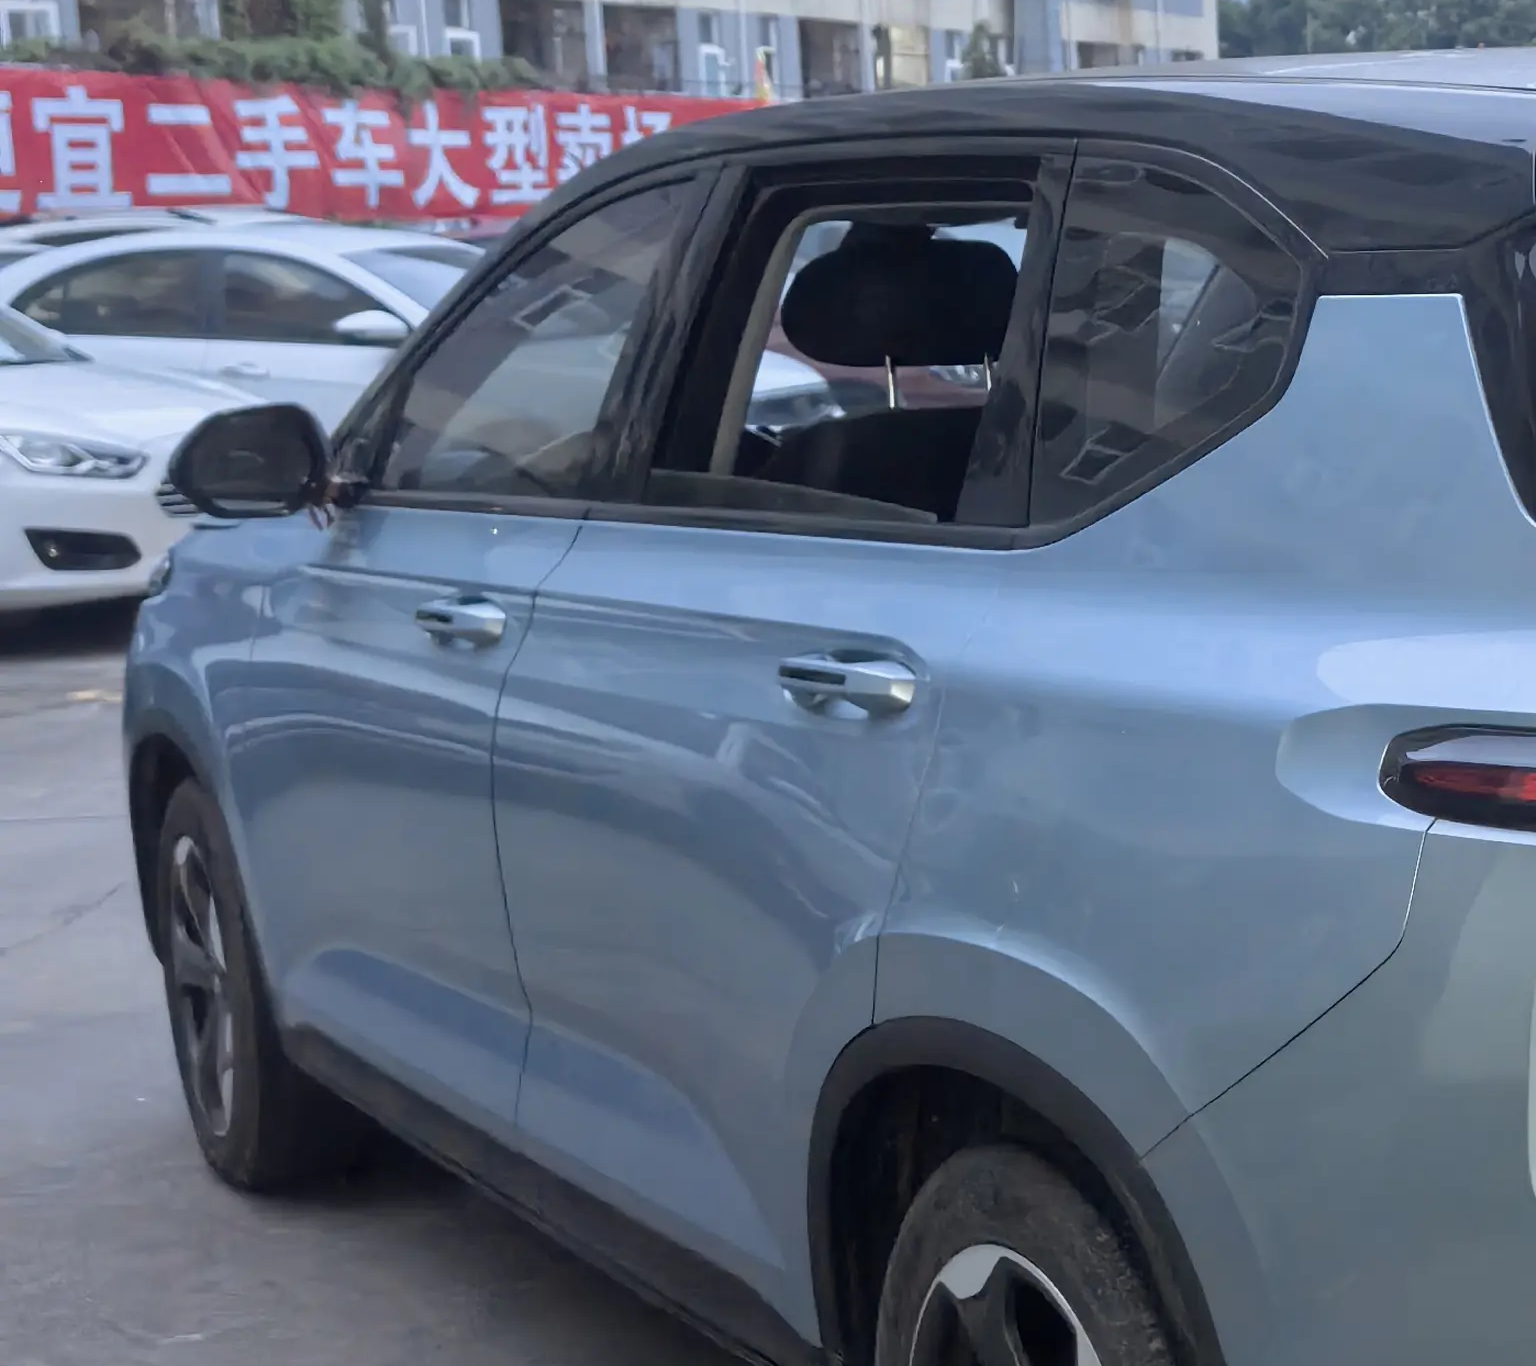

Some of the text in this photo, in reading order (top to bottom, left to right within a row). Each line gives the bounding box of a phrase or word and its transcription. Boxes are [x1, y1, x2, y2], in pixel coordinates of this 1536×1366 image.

[0, 86, 673, 213] 宜二手车大型卖
